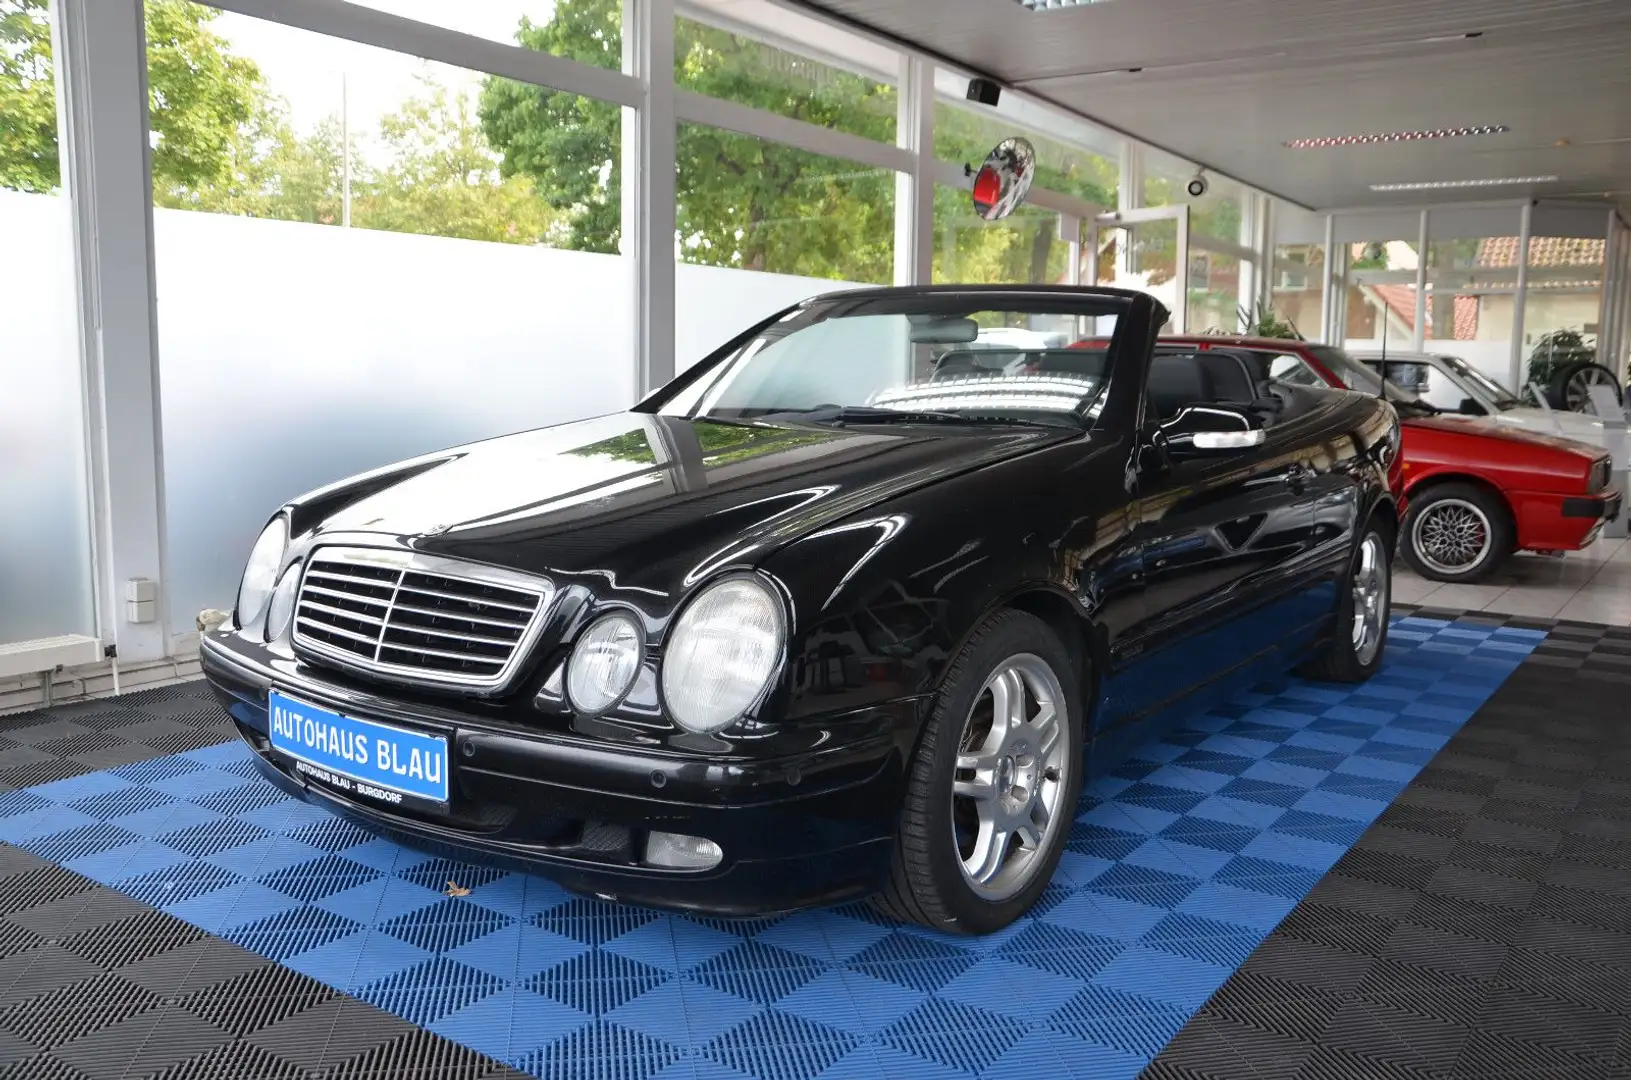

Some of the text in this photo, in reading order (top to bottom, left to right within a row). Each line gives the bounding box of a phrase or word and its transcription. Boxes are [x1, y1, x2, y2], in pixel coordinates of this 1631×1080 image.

[274, 706, 441, 784] AUTOHAUS BLAU
[296, 761, 331, 781] AUTOHAUS
[331, 773, 350, 790] BLAU
[357, 783, 402, 804] BURGDORF
